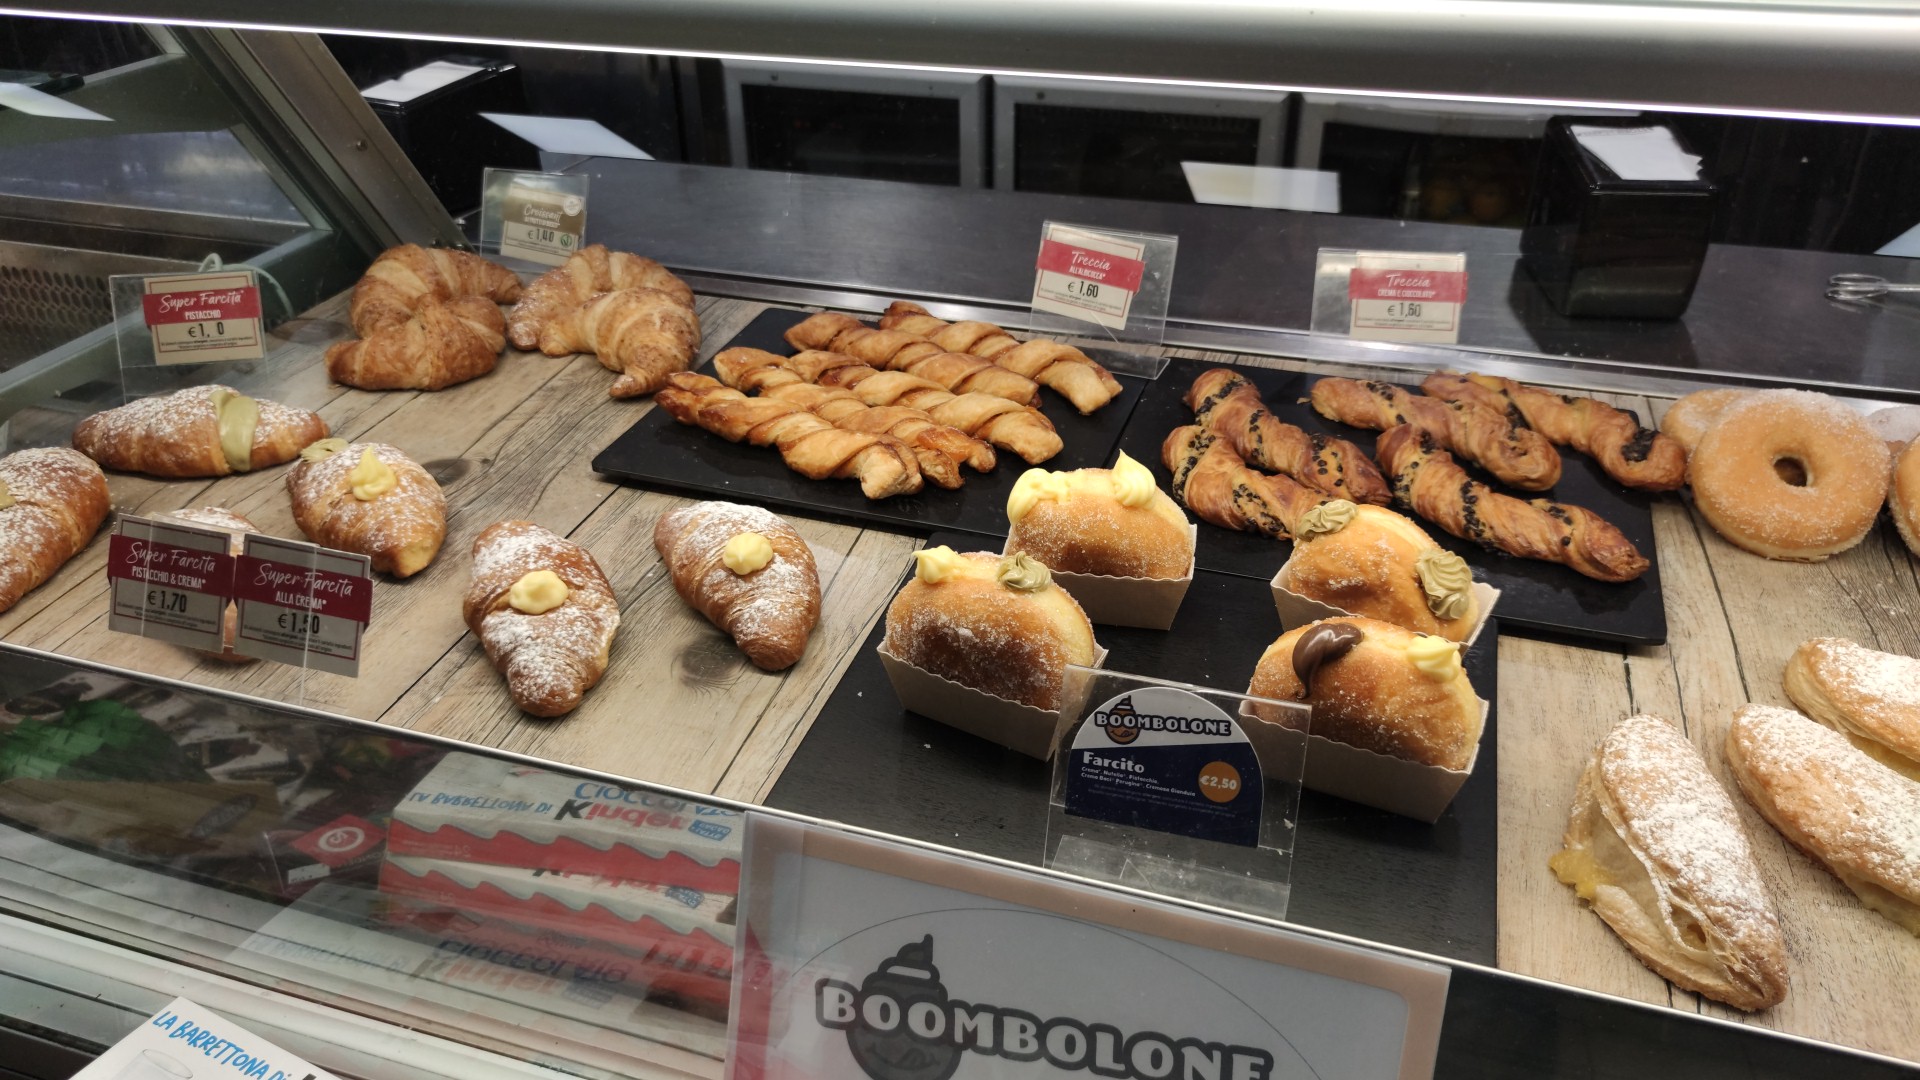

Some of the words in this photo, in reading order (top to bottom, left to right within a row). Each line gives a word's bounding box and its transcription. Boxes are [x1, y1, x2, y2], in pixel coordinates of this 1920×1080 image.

[1071, 251, 1112, 271] Treccia
[1385, 274, 1431, 288] Treccia
[1378, 289, 1396, 297] CREMA
[159, 295, 197, 313] Super
[184, 309, 222, 320] PISTACCHIO
[125, 541, 167, 566] Super
[170, 549, 216, 574] Farcita
[131, 565, 169, 583] PISTACCHIO
[170, 573, 177, 585] &
[253, 563, 301, 589] Super
[304, 571, 354, 597] Farcita
[275, 590, 295, 605] ALLA
[1095, 711, 1231, 736] BOOMBOLONE
[1082, 751, 1145, 774] Farcito
[1200, 775, 1238, 790] €2,50
[815, 977, 1274, 1080] BOOMBOLONE
[152, 1010, 179, 1029] LA
[169, 1020, 270, 1080] BARRETTONA
